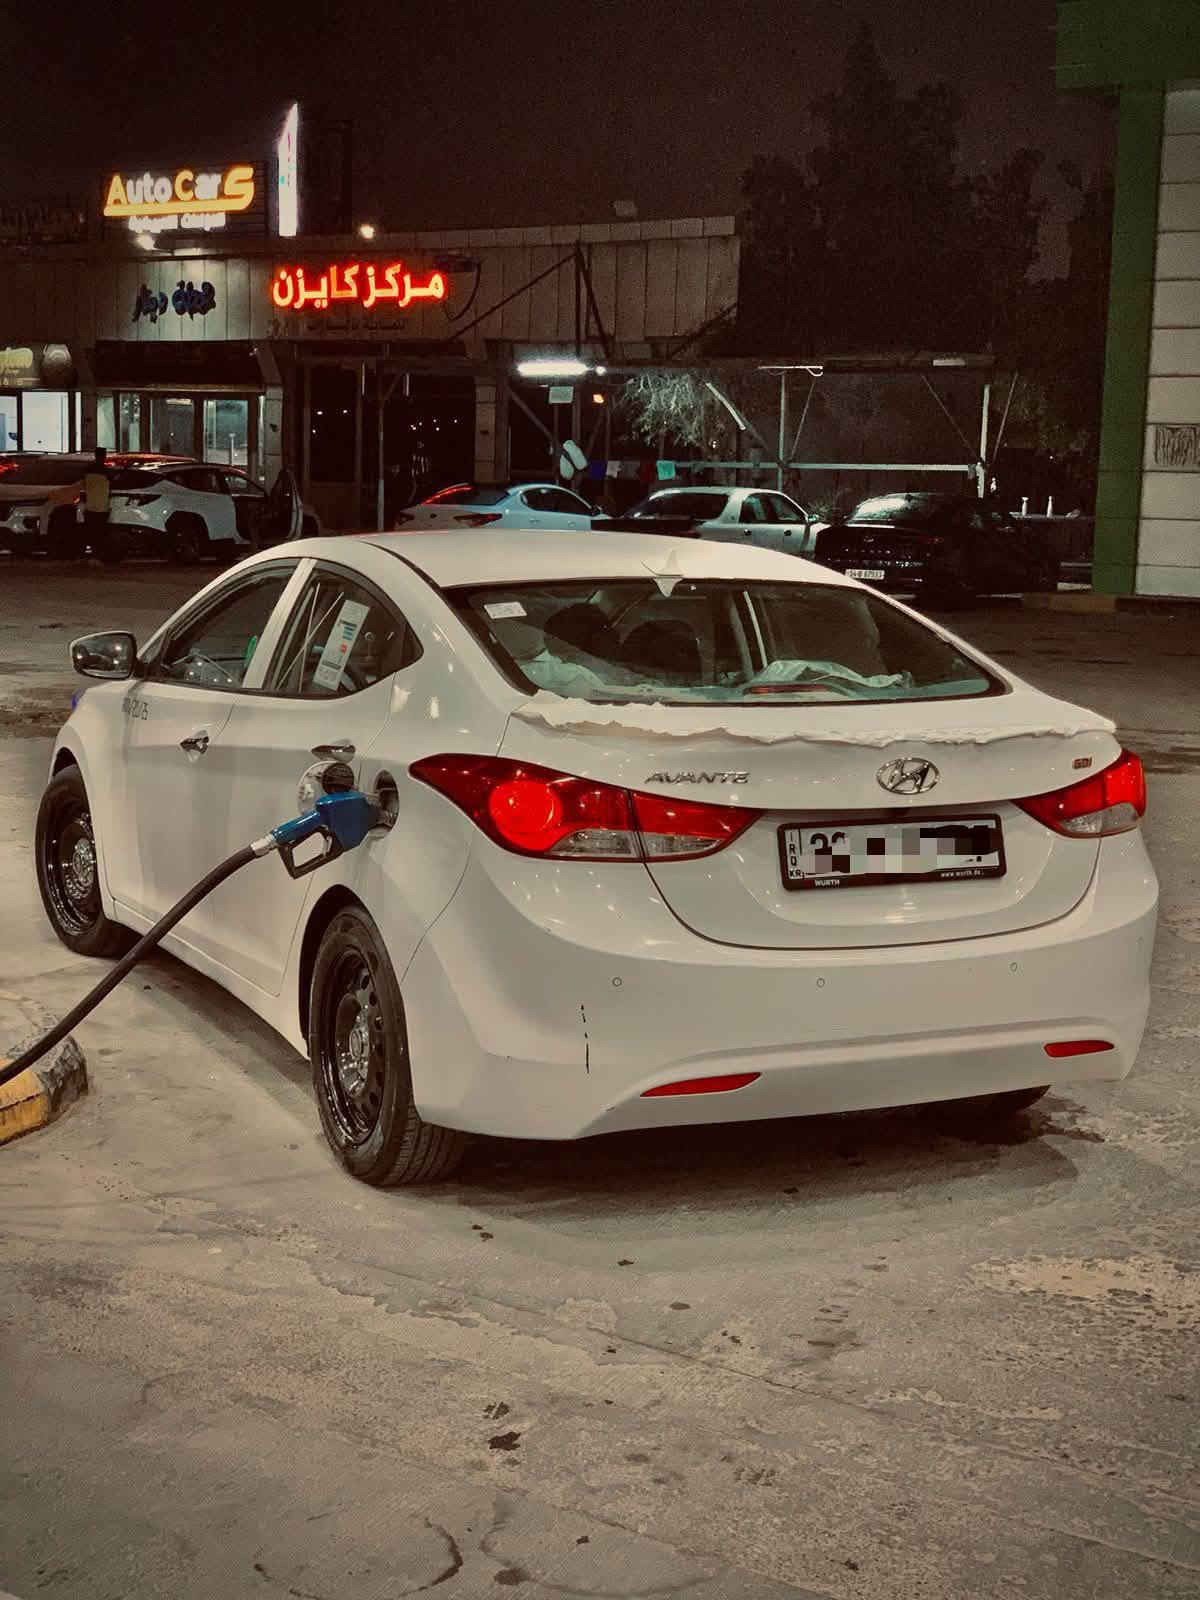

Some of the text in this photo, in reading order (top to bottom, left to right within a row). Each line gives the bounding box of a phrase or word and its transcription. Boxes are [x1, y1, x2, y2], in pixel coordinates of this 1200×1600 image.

[107, 166, 254, 206] Auto Cars
[272, 264, 445, 308] مركز كايزن
[645, 771, 750, 784] AVANTE
